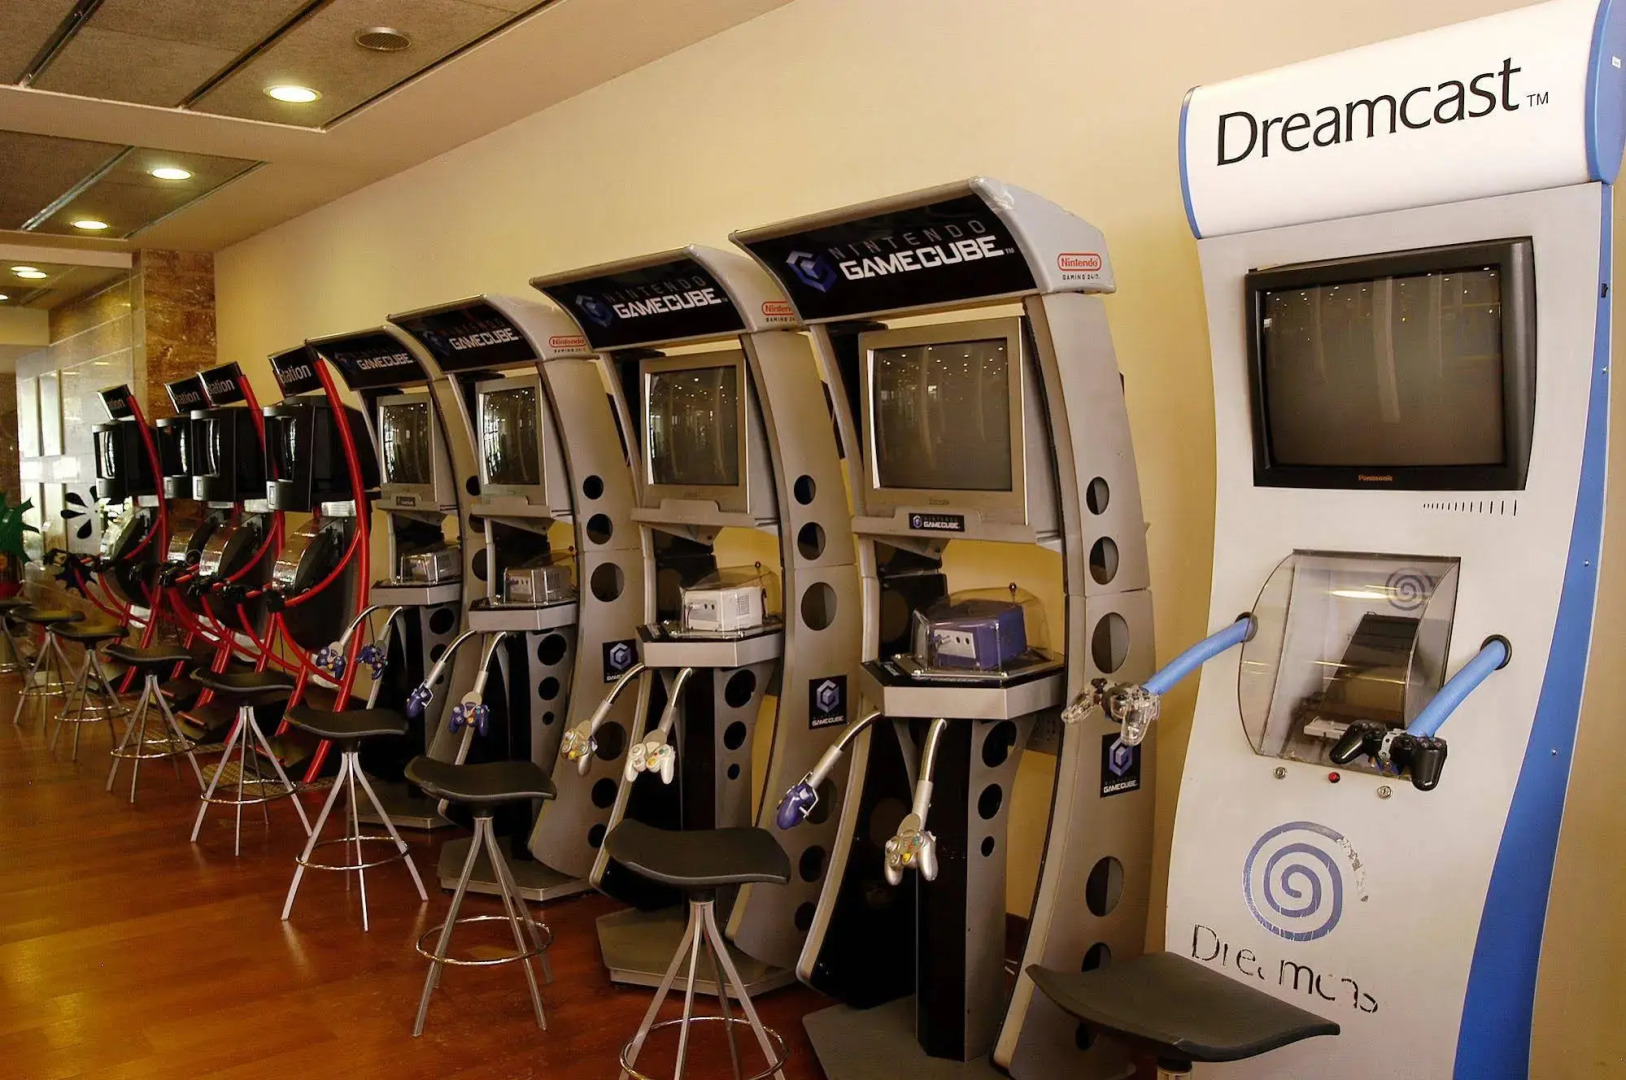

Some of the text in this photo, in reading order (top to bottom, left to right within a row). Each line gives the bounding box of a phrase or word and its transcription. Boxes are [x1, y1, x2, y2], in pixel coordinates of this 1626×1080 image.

[1216, 57, 1522, 166] Dreamcast
[827, 219, 988, 260] NINTENDO
[839, 234, 1004, 282] GAMECUBE
[1061, 257, 1099, 268] Nintendo
[602, 275, 707, 303] NINTENDO
[612, 287, 722, 320] GAMECUBE
[449, 327, 520, 351] GAMECUBE
[356, 352, 415, 371] GAMECUBE
[1358, 474, 1393, 482] Panasonic
[924, 521, 959, 529] GAMECUBE
[1103, 779, 1137, 794] GAMECUBE
